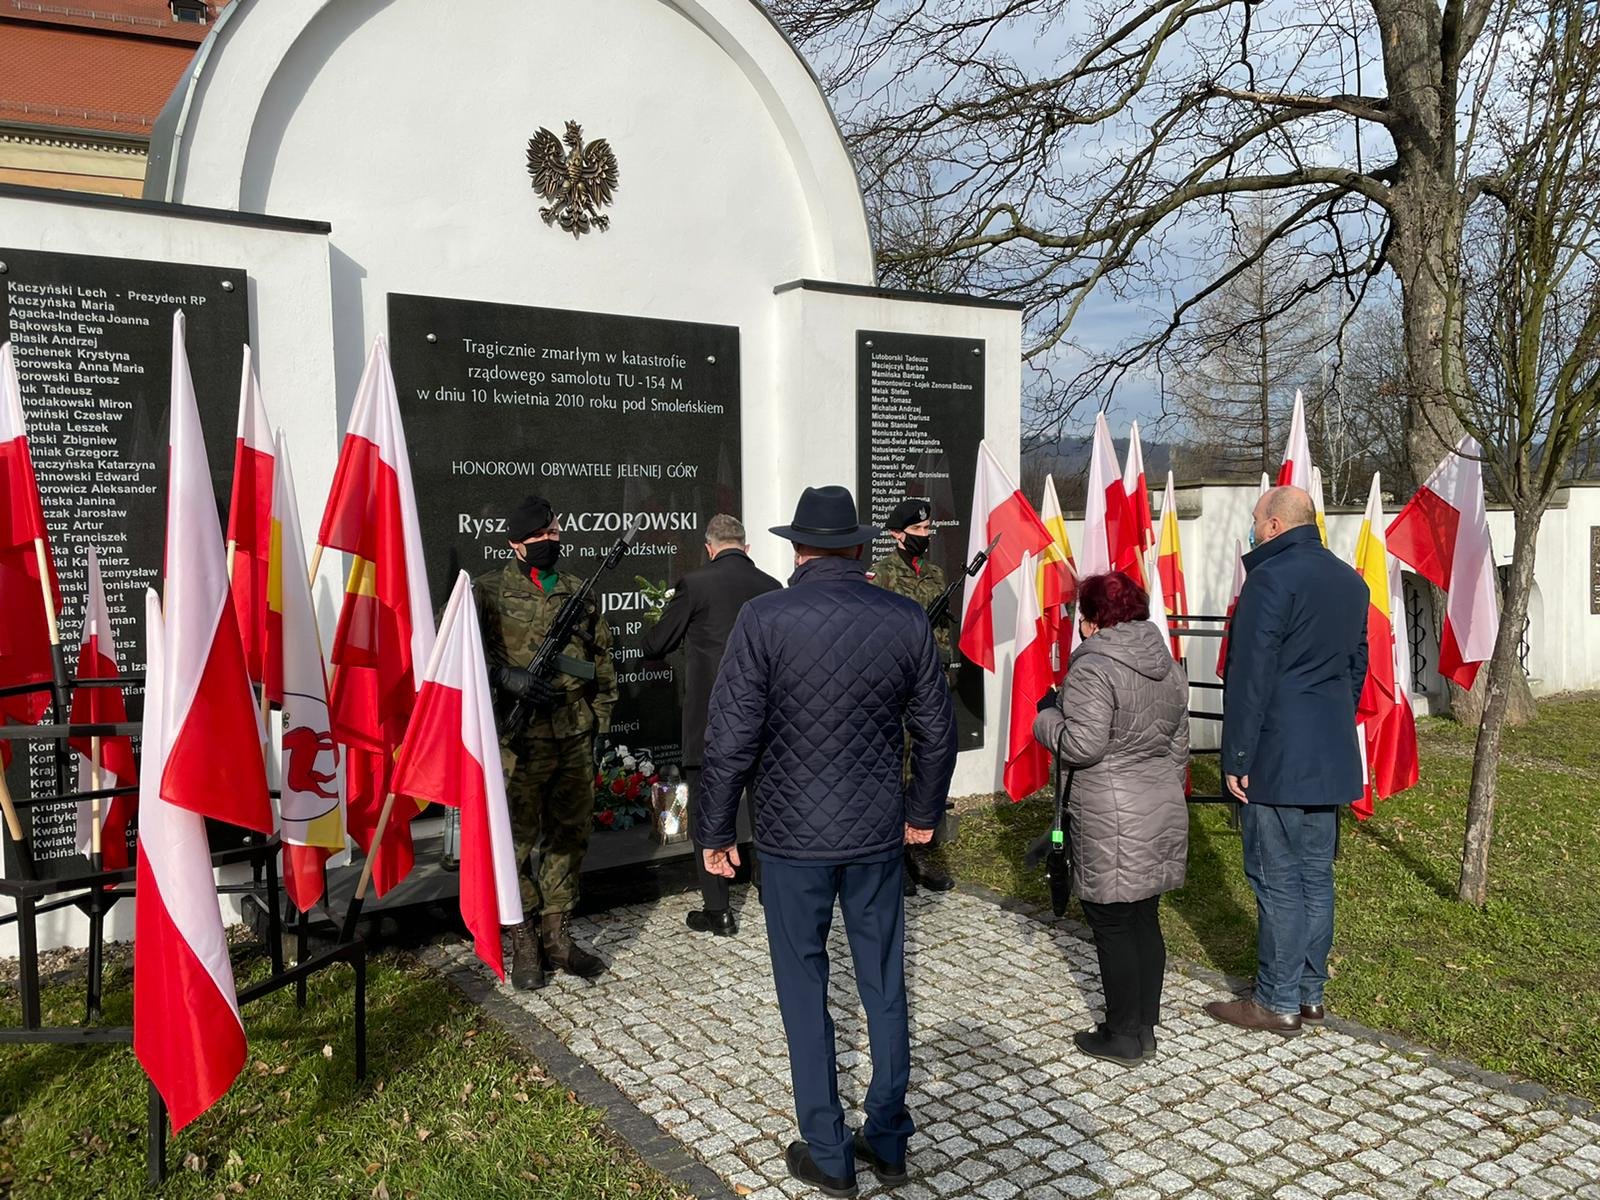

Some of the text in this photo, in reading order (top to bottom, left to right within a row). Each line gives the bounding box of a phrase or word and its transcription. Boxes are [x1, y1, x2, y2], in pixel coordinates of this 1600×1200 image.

[7, 281, 73, 298] Kaczyński
[77, 287, 107, 298] Lech
[128, 291, 186, 307] Prezydent
[190, 296, 206, 306] RP
[8, 295, 115, 311] Kaczyńska Maria
[107, 314, 150, 326] Joanna
[9, 320, 103, 335] Bąkowska Ewa
[10, 333, 98, 348] Błasik Andrzej
[11, 345, 130, 361] Bochenek Krystyna
[463, 338, 686, 369] Tragicznie zmarłym w katastrofie
[905, 355, 928, 363] Tadeusz
[78, 361, 109, 372] Anna
[113, 363, 145, 374] Maria
[871, 361, 929, 371] Maciejczyk Barbara
[74, 373, 120, 385] Bartosz
[468, 366, 545, 386] rządowego
[551, 371, 611, 387] samolotu
[671, 377, 683, 390] M
[43, 384, 93, 396] Tadeusz
[22, 396, 132, 409] hodakowski Miron
[416, 386, 724, 415] w dniu 10 kwietnia 2010 roku pod Smoleńskiem
[890, 396, 912, 404] Tomasz
[871, 404, 921, 413] Michalak Andrzej
[23, 409, 123, 423] ywiński Czesław
[25, 422, 109, 435] eptuła Leszek
[905, 430, 927, 438] Justyna
[63, 435, 117, 449] Zbigniew
[30, 447, 119, 461] lniak Grzegorz
[33, 460, 156, 471] raczyńska Katarzyna
[452, 461, 699, 479] HONOROWI OBYWATELE JELENIEJ GÓRY
[35, 472, 140, 482] chnowski Edward
[91, 484, 157, 494] Aleksander
[40, 496, 116, 506] ińska Janina
[74, 508, 127, 518] Jarosław
[73, 521, 104, 530] Artur
[458, 514, 511, 539] Rysz
[64, 532, 128, 543] Franciszek
[74, 545, 122, 555] Grżyna
[72, 557, 130, 567] Kamierz
[101, 568, 158, 579] zemysław
[104, 581, 150, 589] ronisław
[626, 622, 642, 635] RP
[613, 667, 673, 684] arodowej
[611, 719, 640, 733] mięci
[33, 823, 76, 837] Kwaśni
